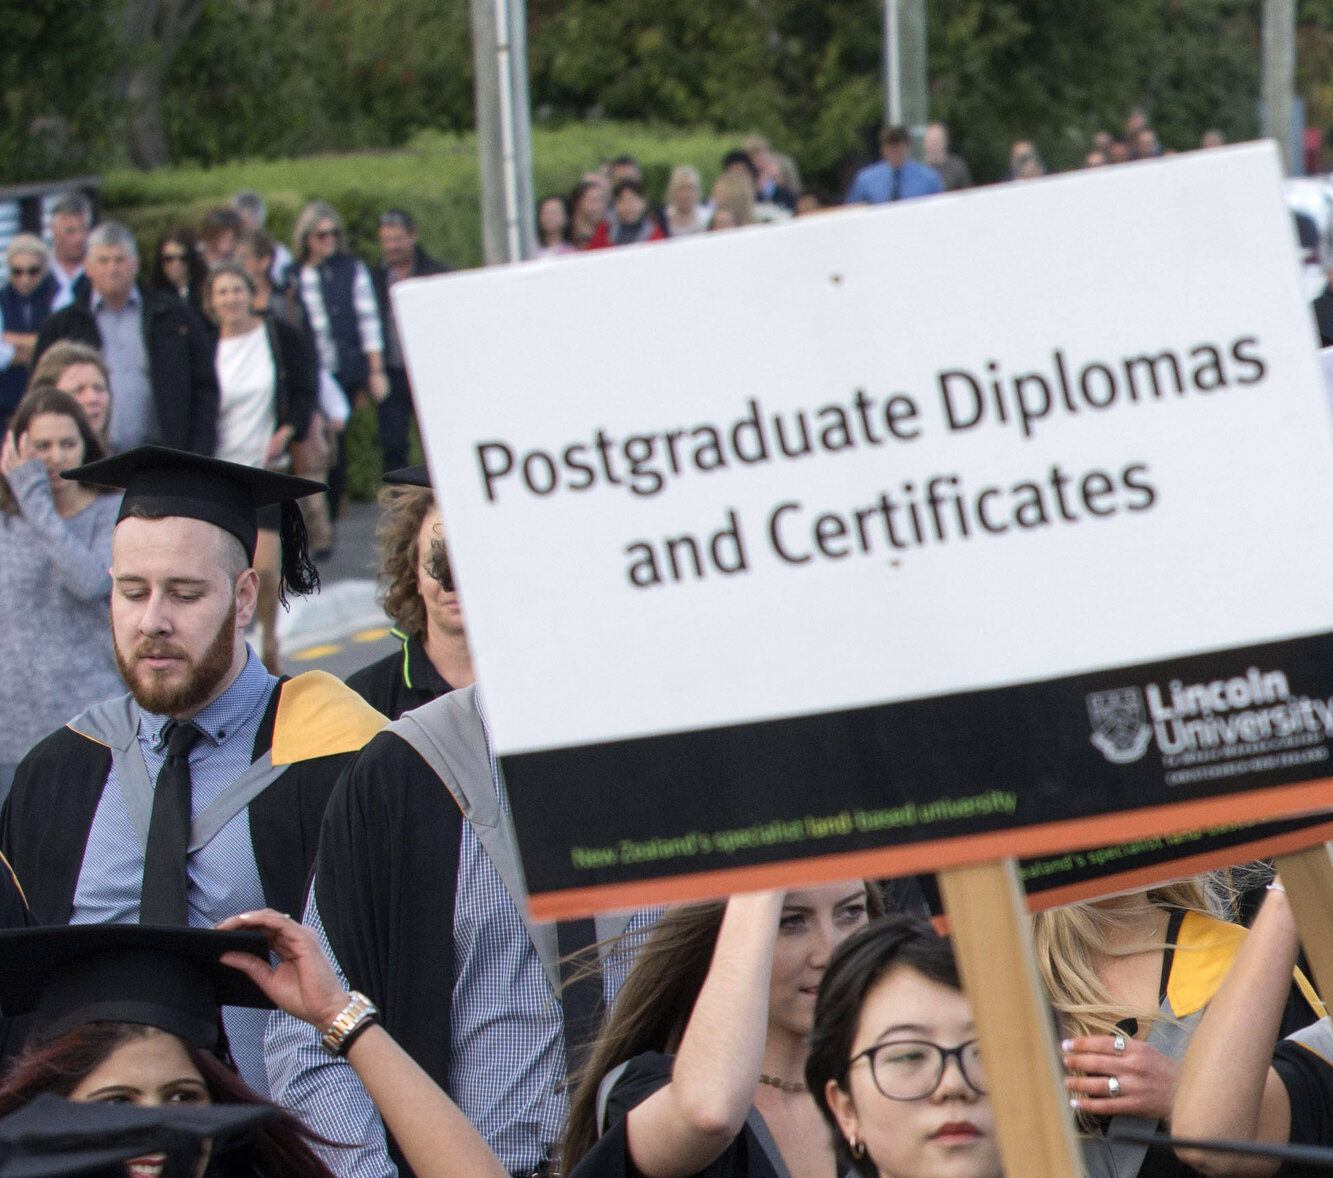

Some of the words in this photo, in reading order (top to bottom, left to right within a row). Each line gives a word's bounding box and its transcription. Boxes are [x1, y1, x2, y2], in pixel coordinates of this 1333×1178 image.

[474, 395, 922, 506] Postgraduate
[936, 333, 1269, 440] Diplomas
[622, 508, 750, 588] and
[766, 460, 1160, 567] Certificates
[1146, 666, 1291, 721] Lincoln
